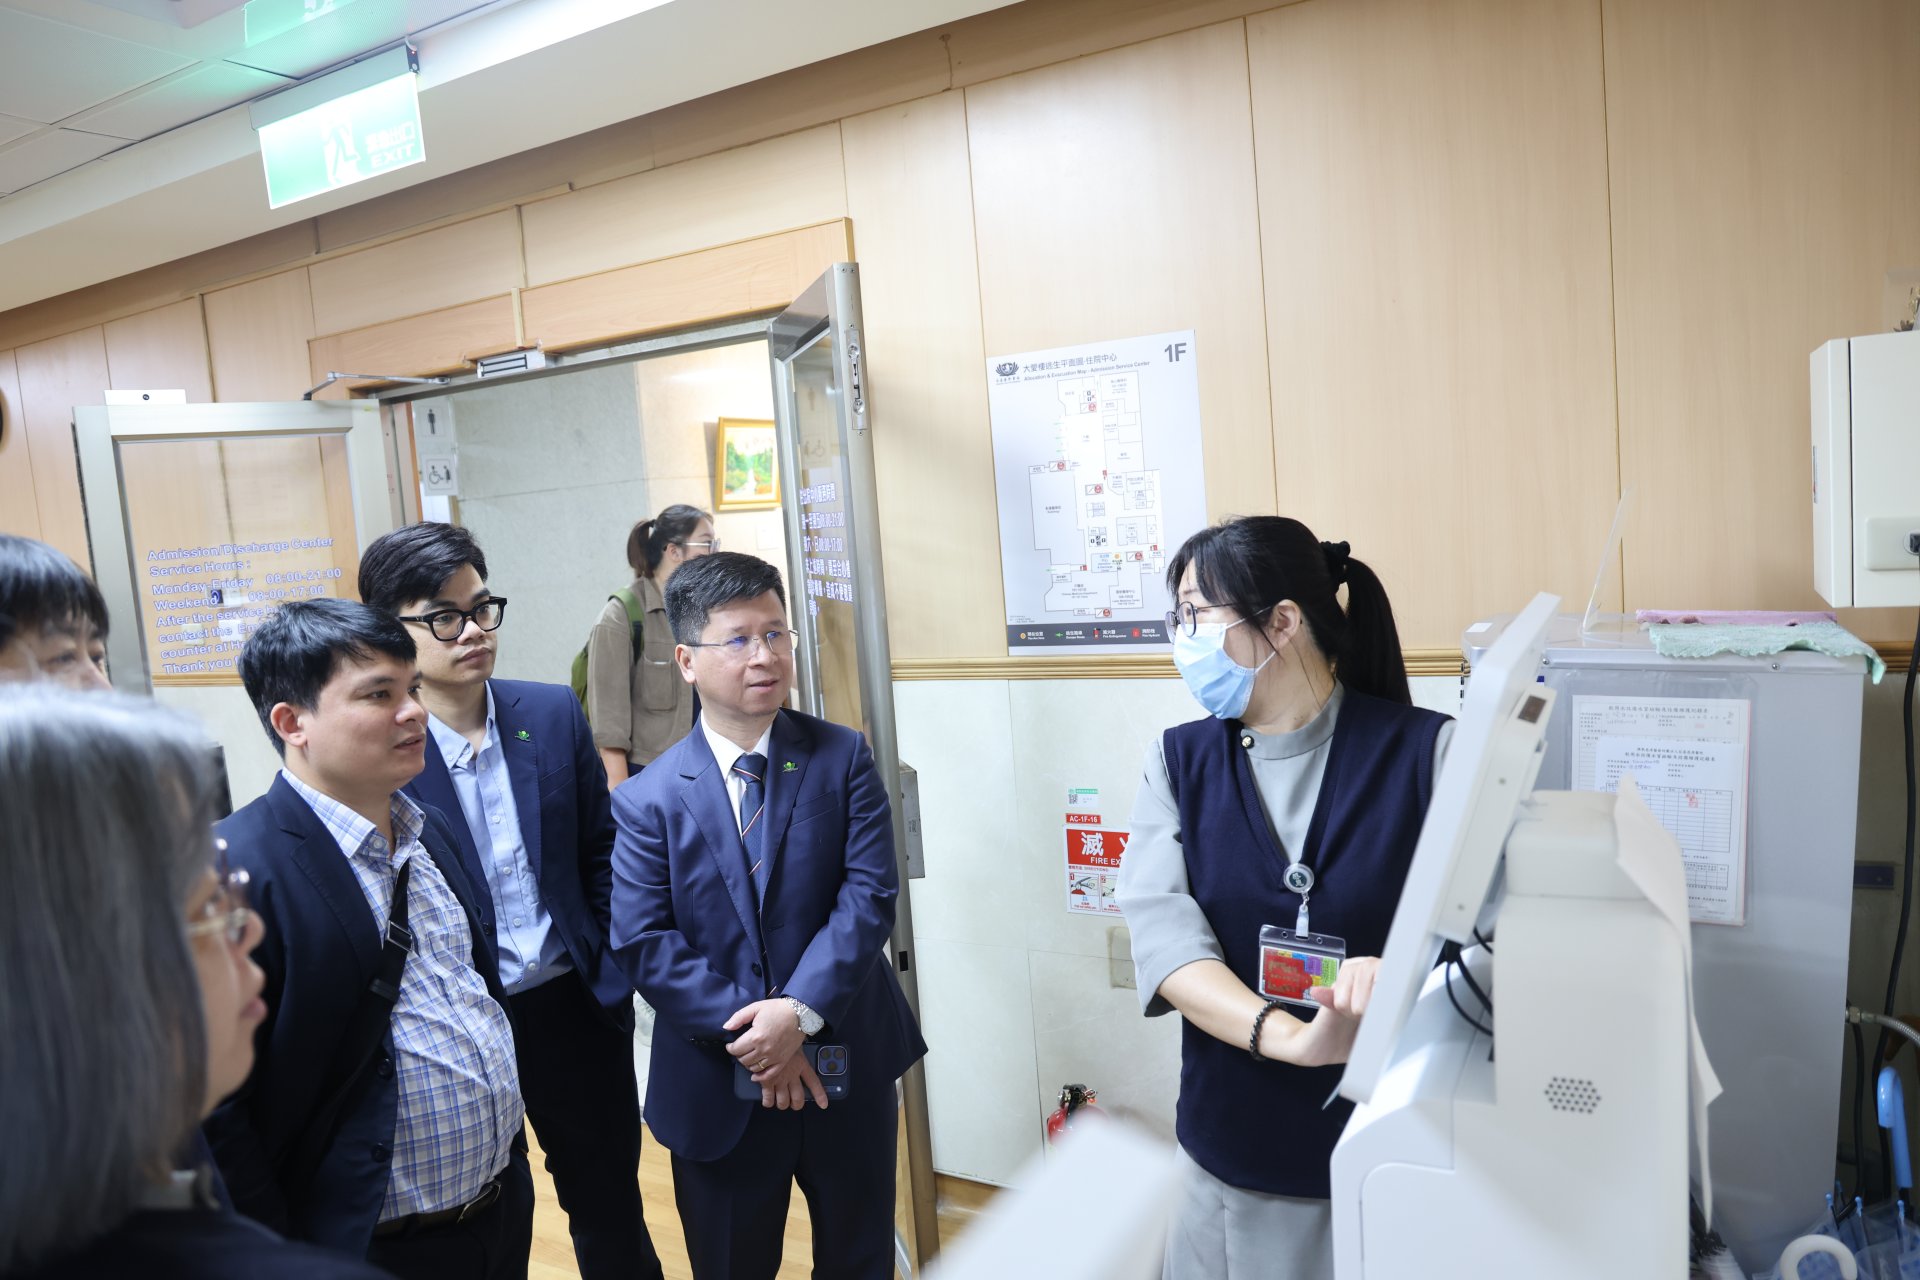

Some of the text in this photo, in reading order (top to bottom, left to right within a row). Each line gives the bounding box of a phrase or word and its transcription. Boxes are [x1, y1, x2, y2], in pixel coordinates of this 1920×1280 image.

[371, 143, 415, 168] EXIT
[1164, 342, 1187, 363] 1F
[147, 536, 334, 561] Admission/Discharge Center
[150, 564, 202, 577] Service
[204, 560, 244, 572] Hours
[152, 568, 342, 595] Monday-Friday 08:00-21:00
[154, 585, 326, 611] Weekend 08:00-17:00
[156, 615, 190, 628] After
[192, 611, 213, 623] the
[217, 606, 264, 620] service
[159, 628, 208, 643] contact
[212, 625, 233, 636] the
[161, 645, 212, 659] counter
[215, 641, 228, 652] at
[163, 660, 206, 674] Thank
[208, 659, 232, 670] you
[1069, 815, 1098, 823] AC-1F-16
[1090, 856, 1109, 865] FIRE
